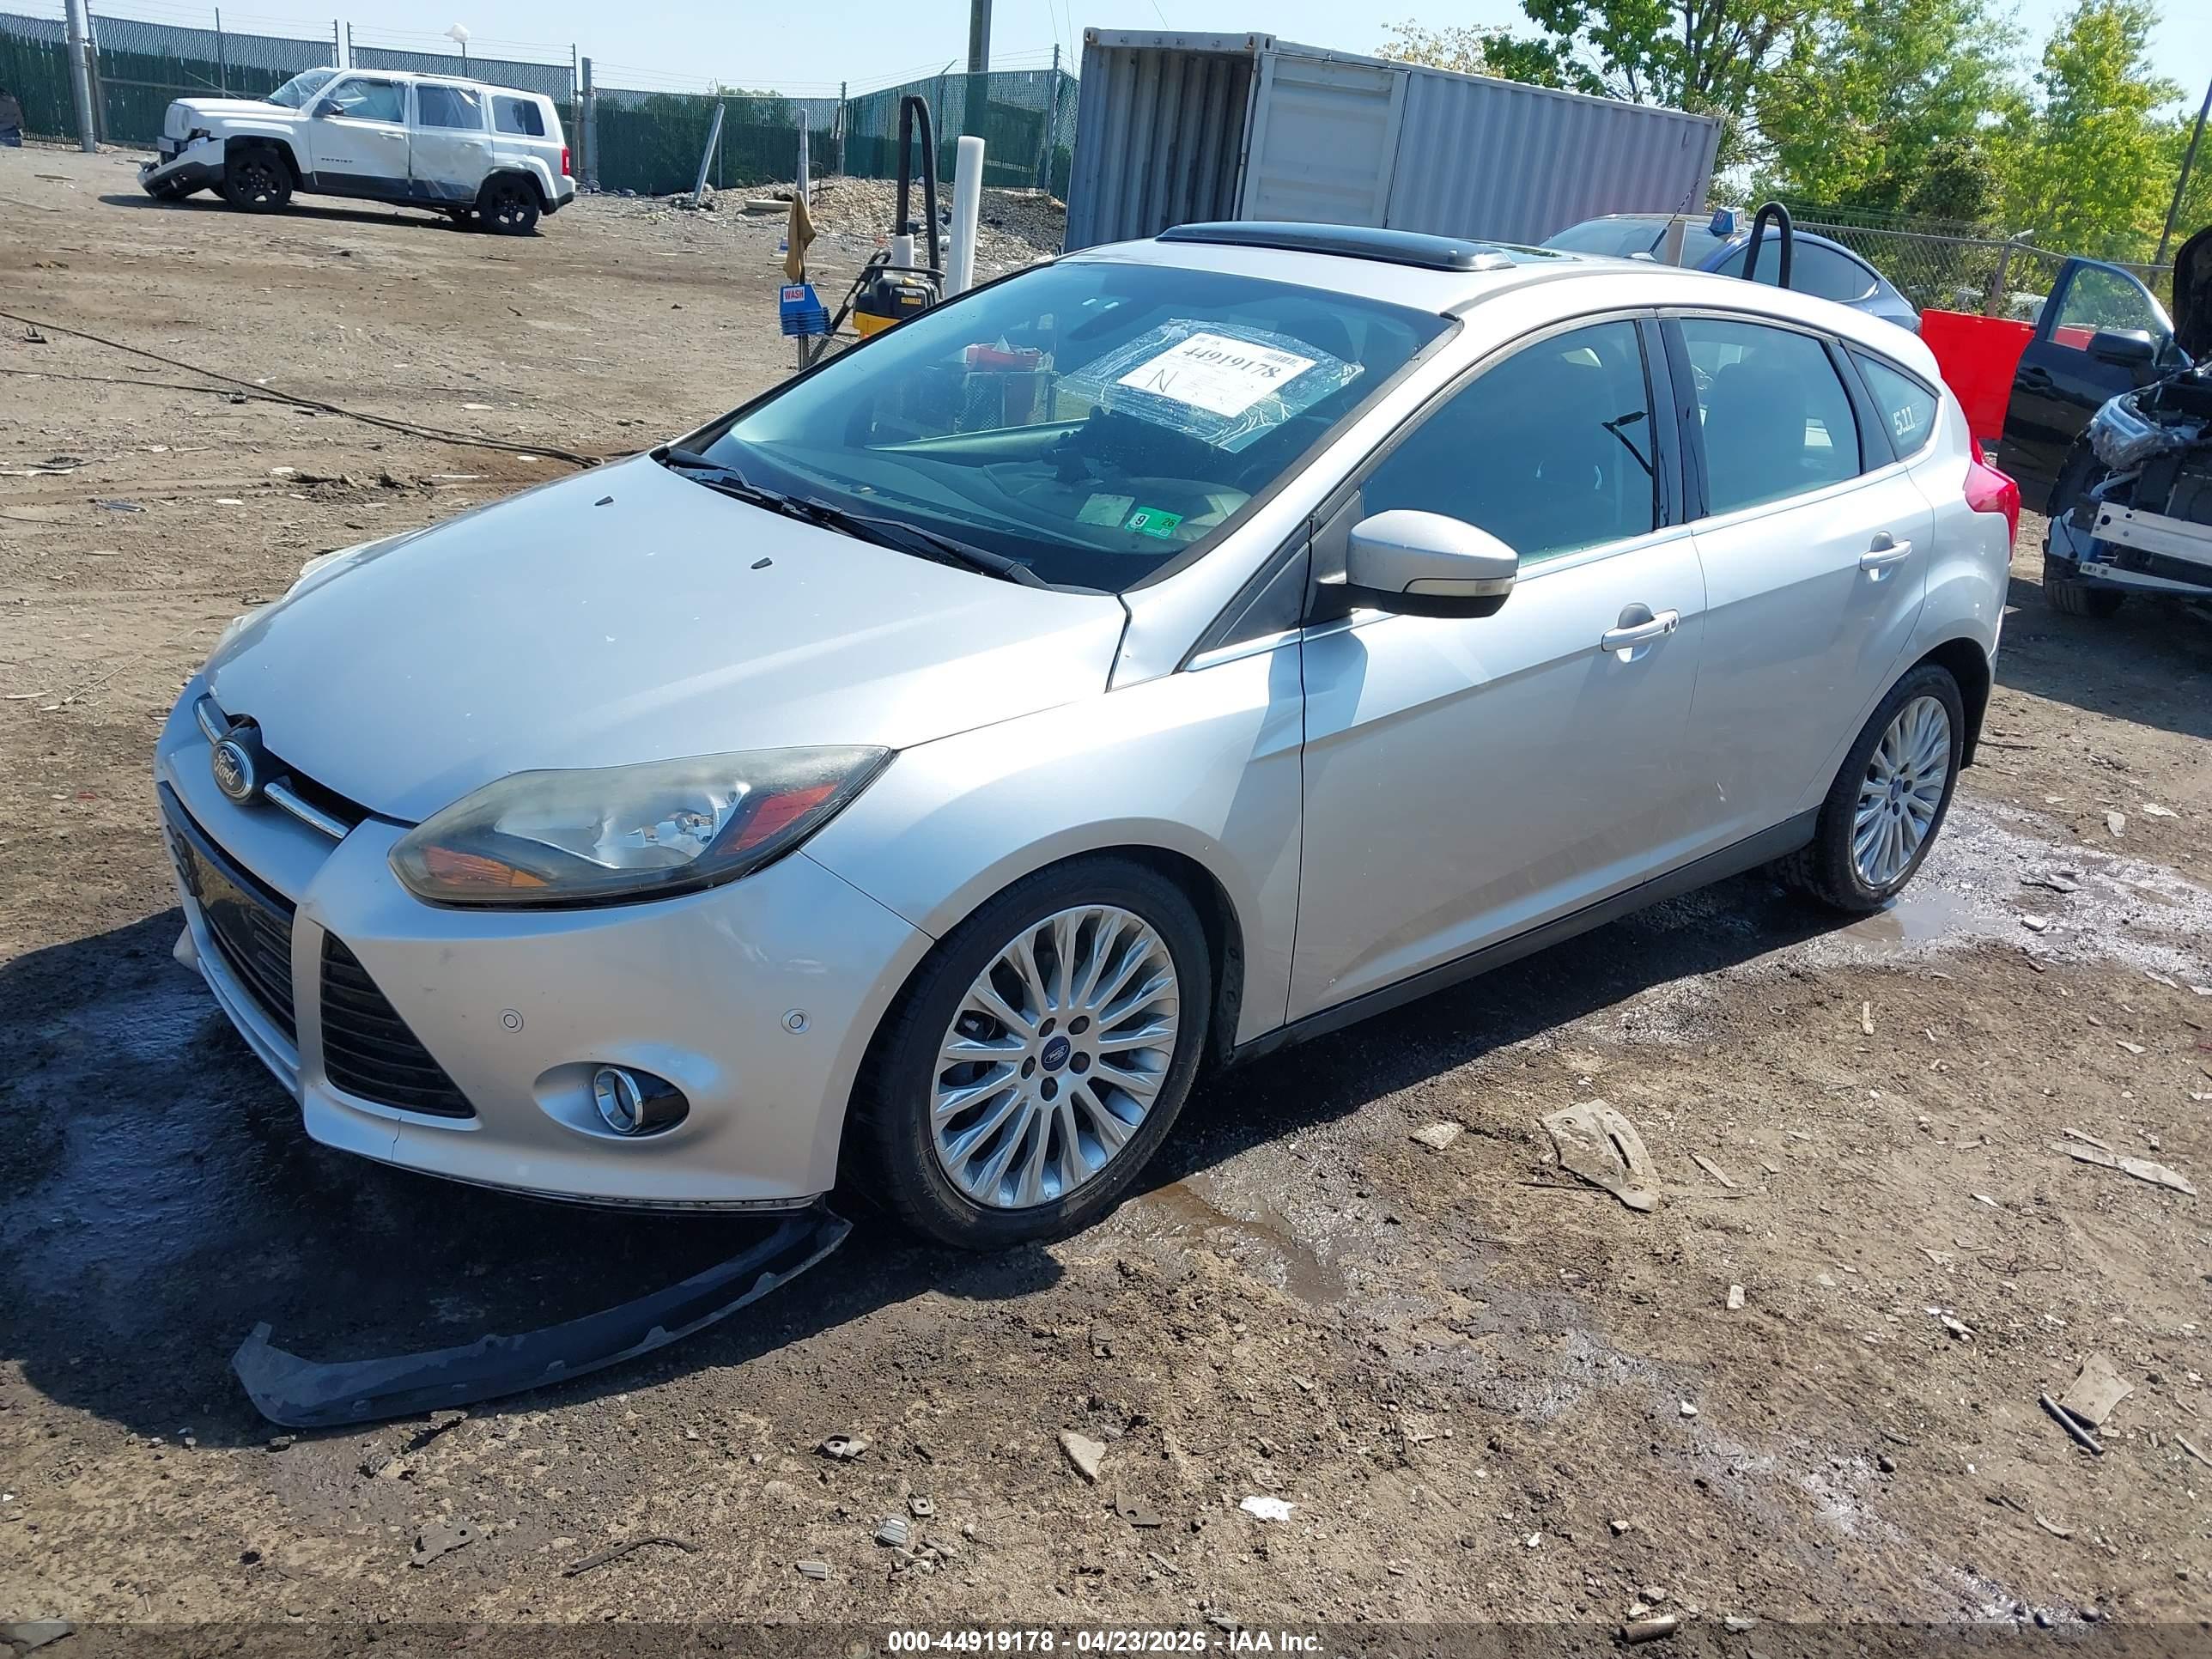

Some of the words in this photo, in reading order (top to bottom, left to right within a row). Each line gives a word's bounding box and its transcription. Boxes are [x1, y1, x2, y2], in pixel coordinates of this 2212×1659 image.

[784, 289, 804, 300] WASH
[1183, 346, 1281, 379] 44919178
[1146, 368, 1179, 392] N
[1135, 515, 1146, 526] 9
[214, 749, 239, 786] Ford
